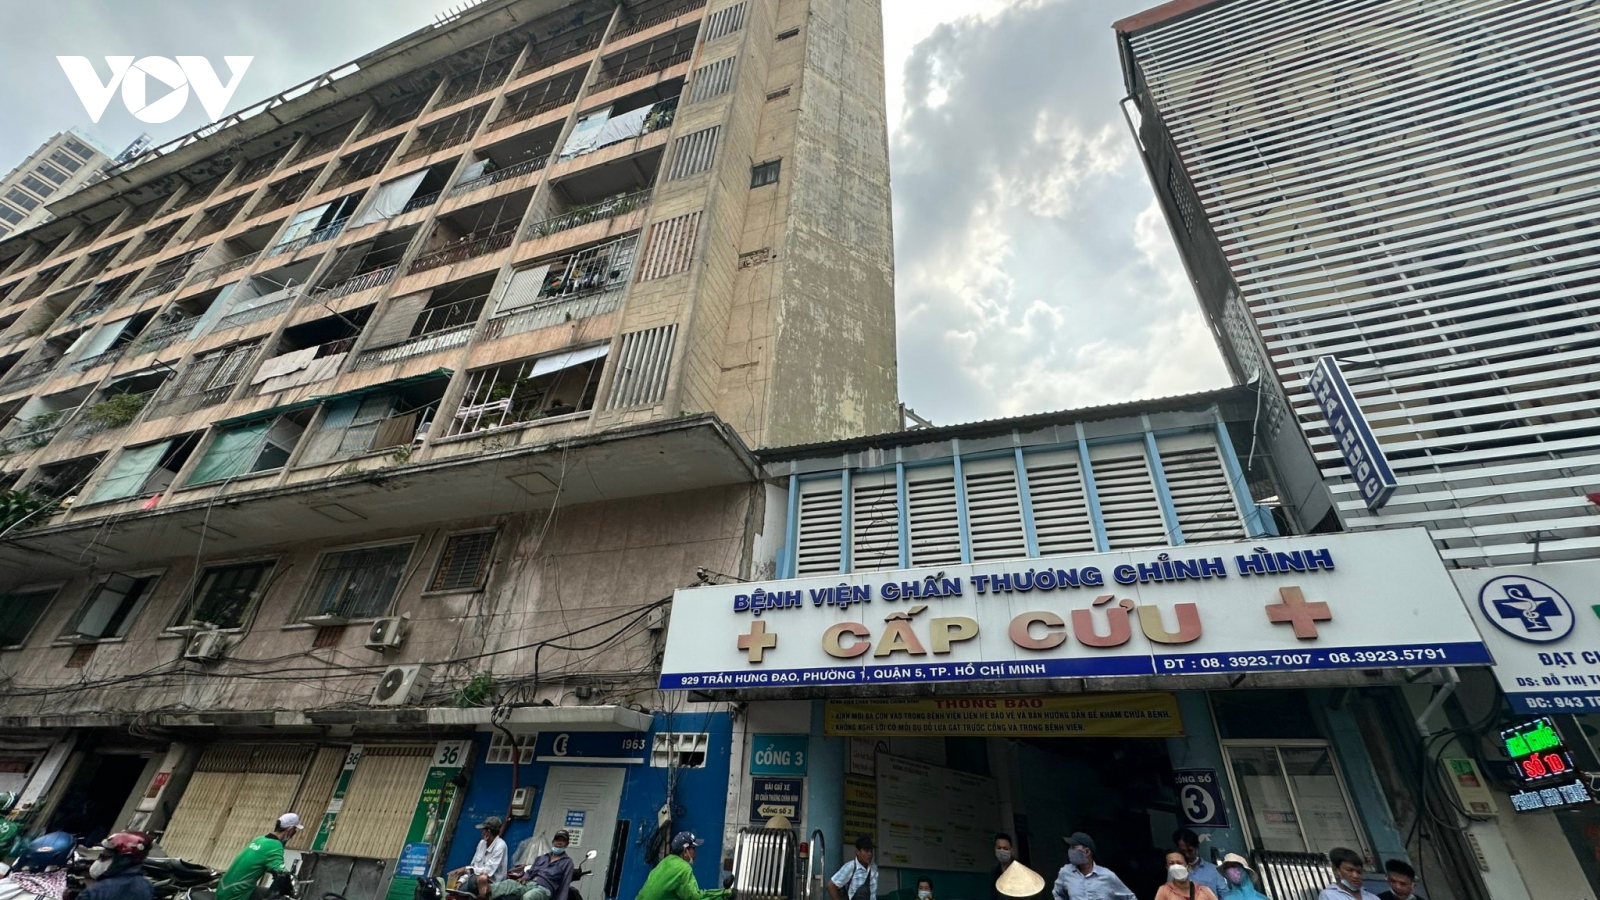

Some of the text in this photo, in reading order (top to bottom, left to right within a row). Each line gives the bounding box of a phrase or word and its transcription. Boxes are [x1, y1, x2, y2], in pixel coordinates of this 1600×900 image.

[734, 547, 1334, 615] BỆNH VIỆN CHẤN THƯƠNG CHỈNH HÌNH
[822, 595, 1202, 658] CẤP CỨU
[1164, 658, 1185, 669] ĐT
[1200, 658, 1225, 668] 08.
[1230, 654, 1312, 666] 3923.7007
[1328, 648, 1447, 664] 08.3923.5791
[1538, 652, 1576, 668] ĐẠT
[681, 676, 699, 685] 929
[736, 673, 768, 684] HƯNG
[771, 672, 799, 684] ĐẠO,
[803, 669, 856, 682] PHƯỜNG
[860, 669, 870, 680] 1,
[874, 666, 912, 679] QUẬN
[915, 668, 926, 678] 5,
[930, 667, 951, 677] TP.
[955, 662, 975, 676] HỒ
[980, 663, 1004, 676] CHÍ
[1009, 664, 1046, 674] MINH
[1516, 677, 1540, 686] DS:
[1562, 676, 1588, 686] THỊ
[1526, 697, 1553, 708] ĐC:
[1554, 697, 1584, 708] 943
[622, 739, 646, 750] 1963
[346, 752, 360, 764] 36
[439, 746, 460, 764] 36
[755, 743, 804, 766] CỔNG 3
[1544, 754, 1565, 772] 10
[1197, 772, 1212, 783] SỐ
[762, 806, 778, 814] CỔNG
[779, 806, 786, 814] SỐ
[1185, 788, 1208, 820] 3
